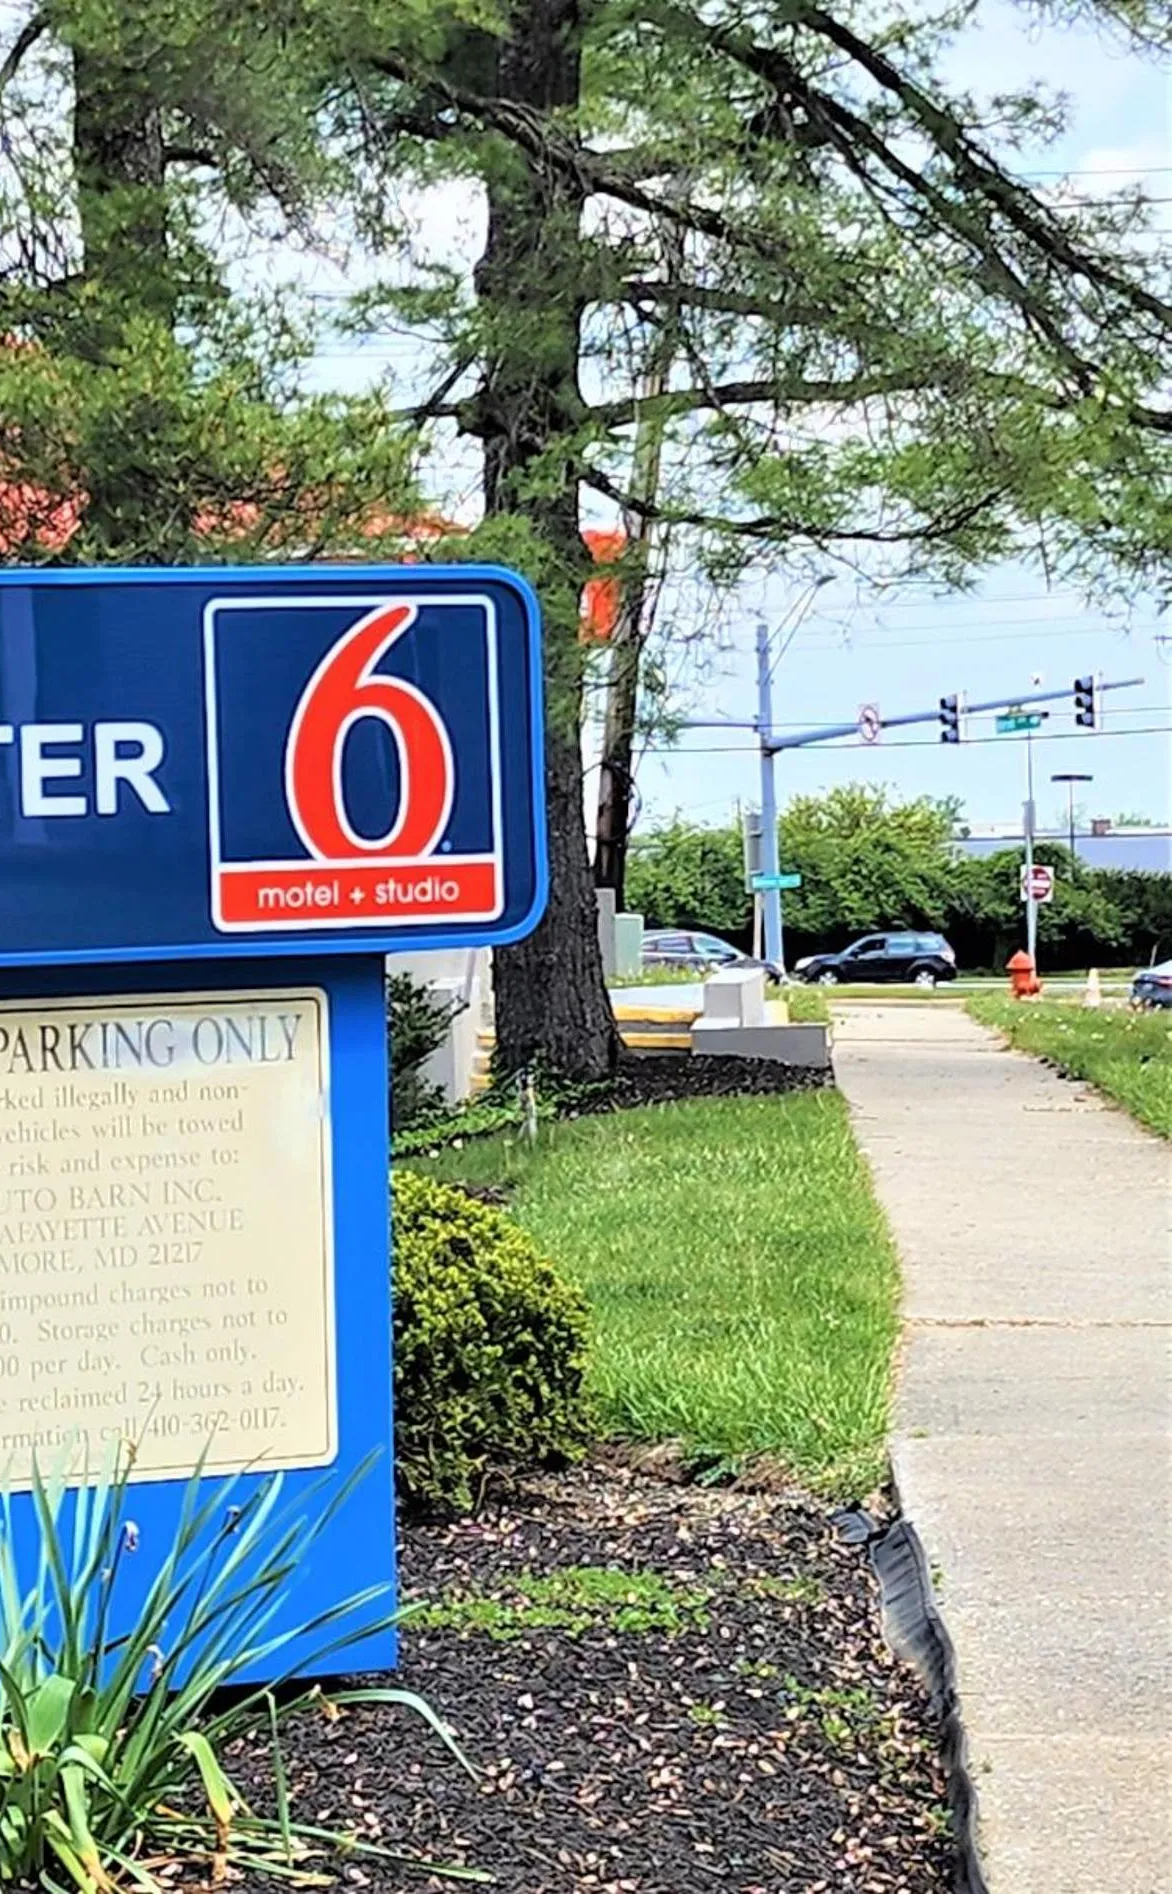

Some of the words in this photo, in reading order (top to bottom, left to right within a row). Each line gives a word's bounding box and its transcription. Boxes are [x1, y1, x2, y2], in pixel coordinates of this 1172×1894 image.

[284, 601, 455, 861] 6
[257, 880, 340, 909] motel
[374, 876, 460, 905] studio
[192, 1014, 303, 1066] ONLY
[55, 1081, 138, 1110] illegally
[148, 1081, 188, 1104] and
[199, 1084, 249, 1101] non-
[92, 1116, 132, 1139] will
[142, 1115, 168, 1136] be
[179, 1110, 243, 1135] towed
[9, 1152, 50, 1177] risk
[60, 1150, 101, 1174] and
[110, 1150, 201, 1174] expense
[211, 1148, 240, 1165] to:
[69, 1182, 151, 1211] BARN
[163, 1178, 223, 1204] INC.
[138, 1208, 244, 1237] AVENUE
[94, 1246, 138, 1270] MD
[148, 1241, 204, 1266] 21217
[0, 1283, 98, 1315] impound
[110, 1281, 192, 1305] charges
[202, 1279, 236, 1298] not
[247, 1278, 268, 1295] to
[37, 1318, 119, 1343] Storage
[130, 1312, 211, 1336] charges
[222, 1310, 256, 1329] not
[267, 1309, 288, 1326] to
[31, 1358, 67, 1382] per
[78, 1350, 121, 1376] day.
[140, 1342, 195, 1368] Cash
[206, 1339, 257, 1366] only.
[19, 1382, 127, 1413] reclaimed
[138, 1380, 162, 1403] 24
[172, 1378, 232, 1401] hours
[242, 1378, 253, 1395] a
[263, 1371, 304, 1397] day.
[100, 1418, 137, 1443] call
